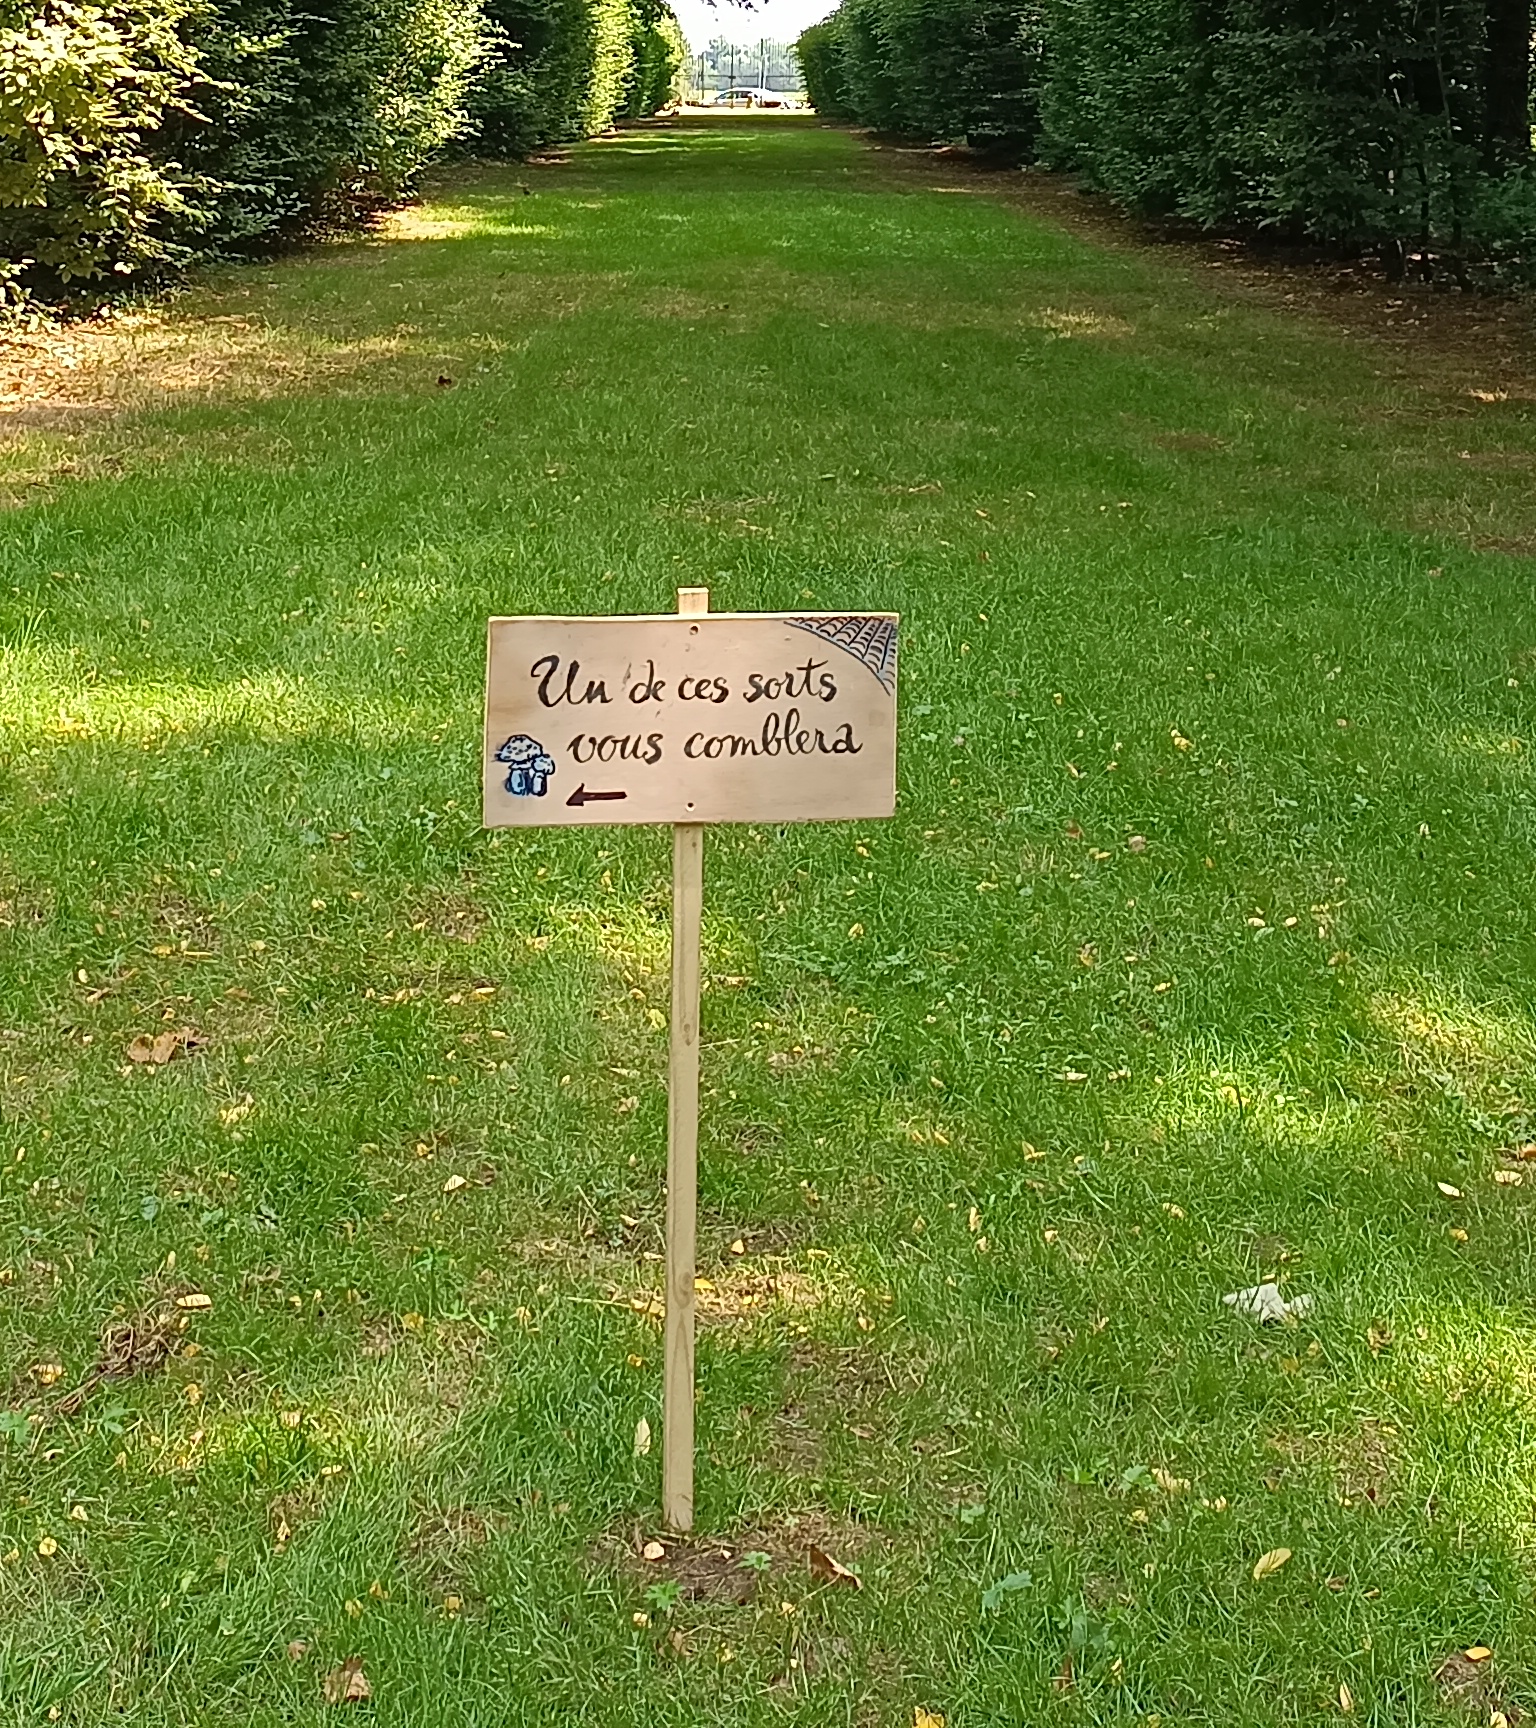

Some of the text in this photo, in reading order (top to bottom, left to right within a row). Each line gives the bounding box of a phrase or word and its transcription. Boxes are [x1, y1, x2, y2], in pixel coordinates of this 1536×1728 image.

[530, 654, 838, 708] Un de ces sorts
[567, 708, 863, 764] vous comblera
